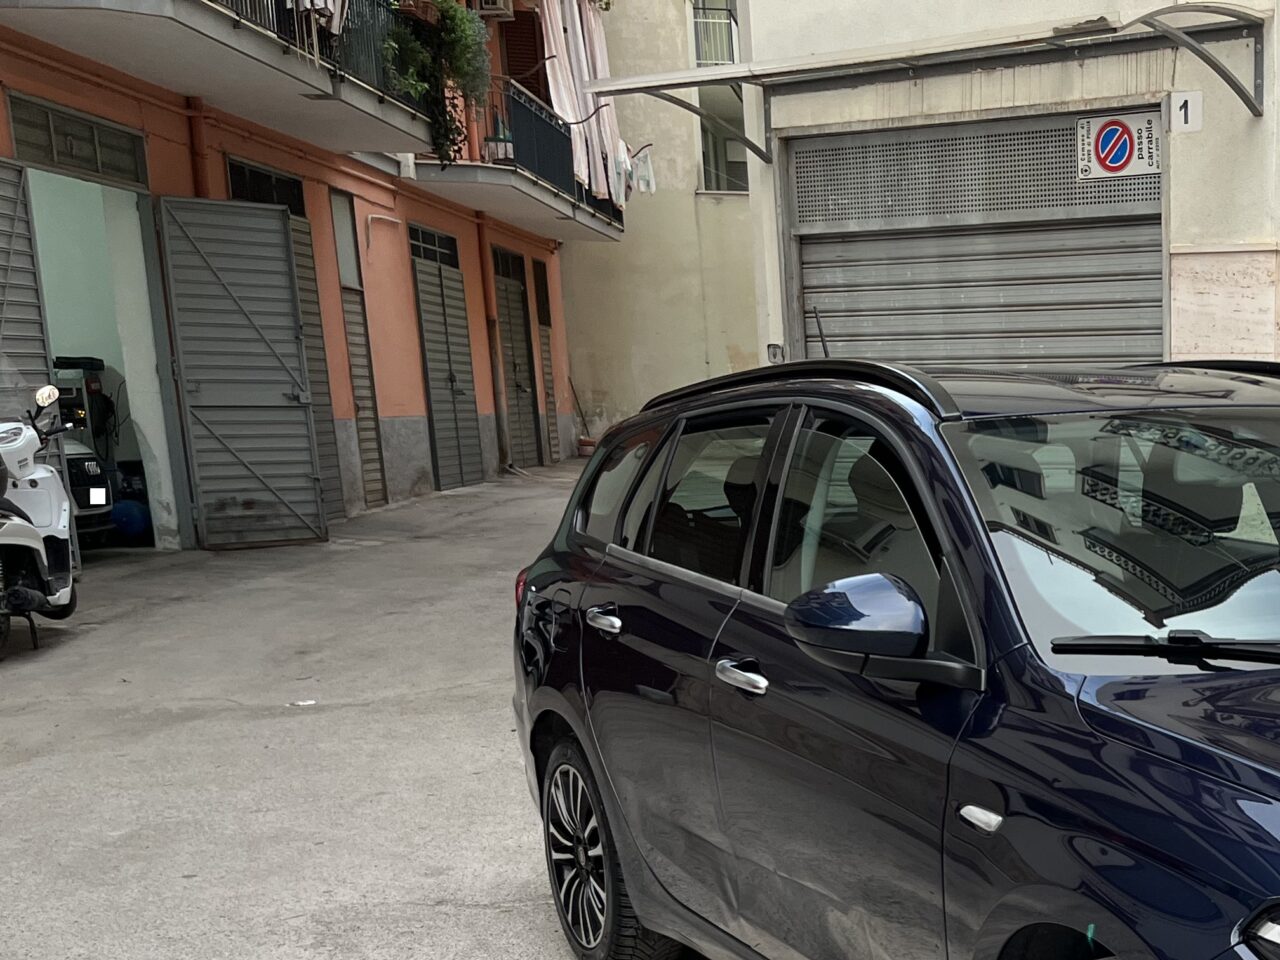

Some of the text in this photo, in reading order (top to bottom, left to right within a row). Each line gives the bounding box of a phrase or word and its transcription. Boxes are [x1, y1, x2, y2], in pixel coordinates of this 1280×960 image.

[1179, 99, 1189, 125] 1
[1137, 128, 1145, 160] passo
[1145, 119, 1154, 167] carrabile
